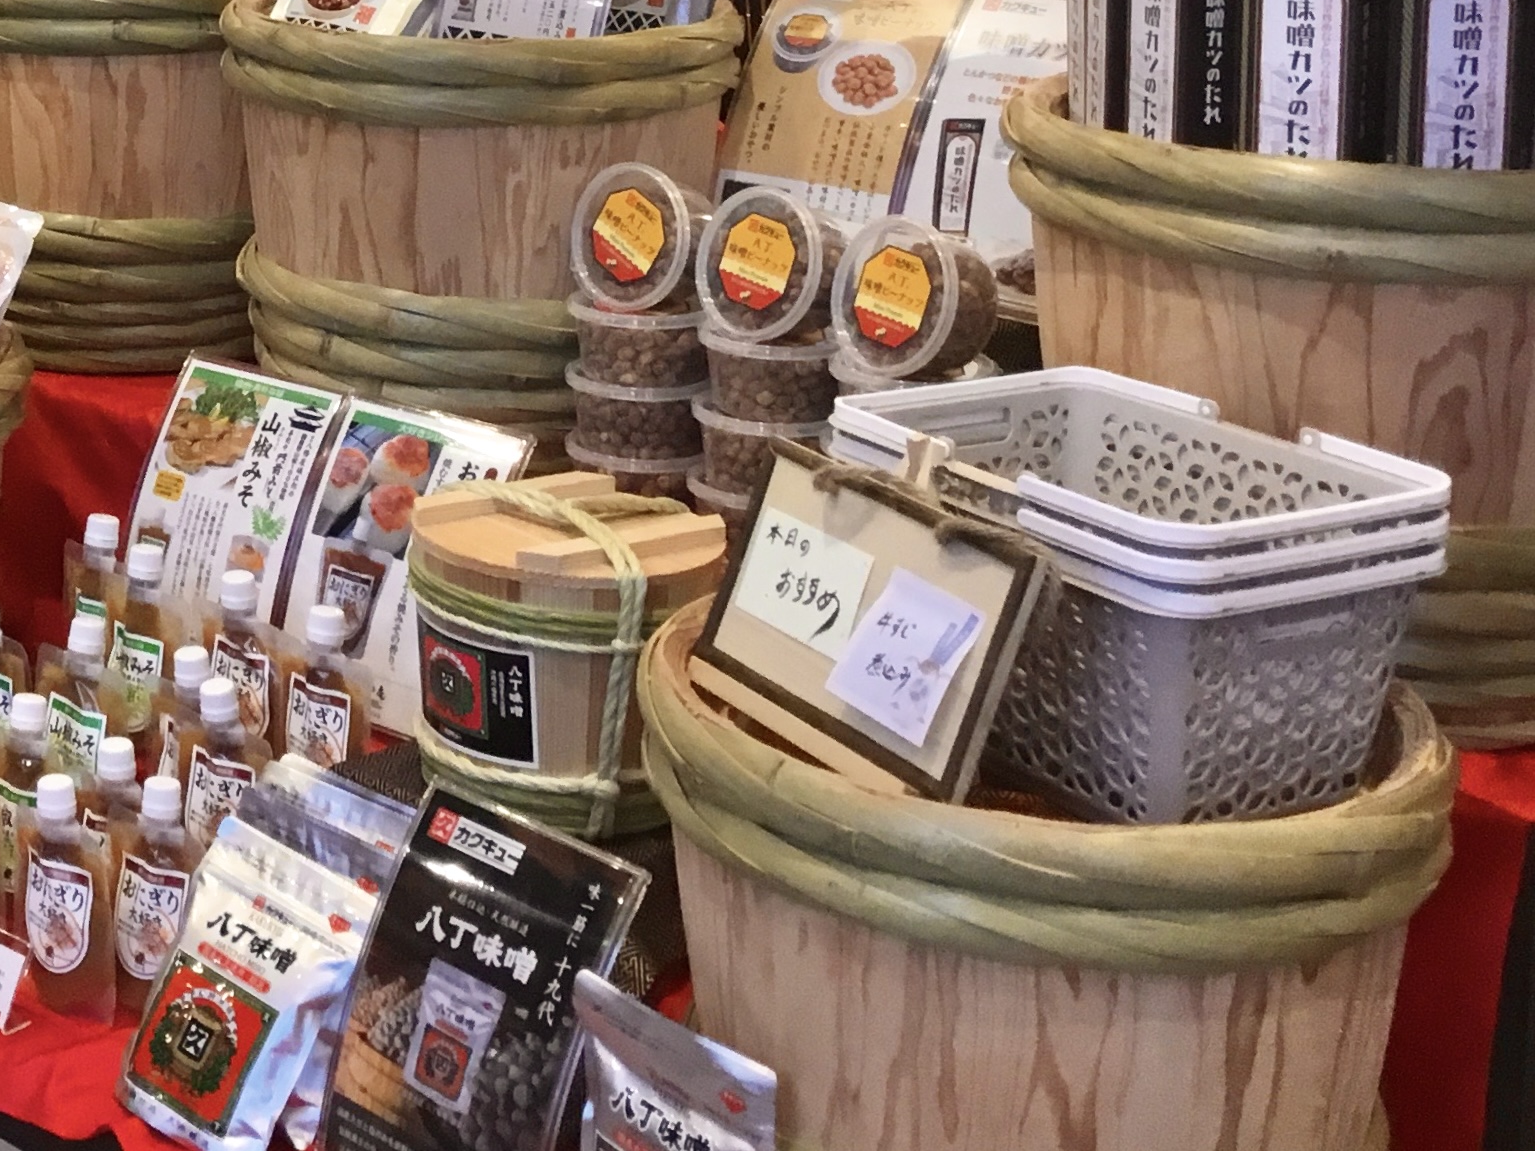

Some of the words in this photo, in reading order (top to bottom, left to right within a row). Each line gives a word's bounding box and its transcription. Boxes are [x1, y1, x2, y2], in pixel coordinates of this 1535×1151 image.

[1002, 0, 1048, 15] カクキュー
[238, 412, 282, 508] 山椒みそ
[766, 522, 811, 558] 本日の
[775, 567, 841, 641] おすすめ
[877, 611, 917, 639] 牛すじ
[865, 652, 912, 696] 煮込み
[454, 826, 522, 863] カクキュー
[207, 911, 298, 975] 八丁味噌
[415, 906, 539, 985] 八丁味噌
[538, 956, 572, 1027] 十九代
